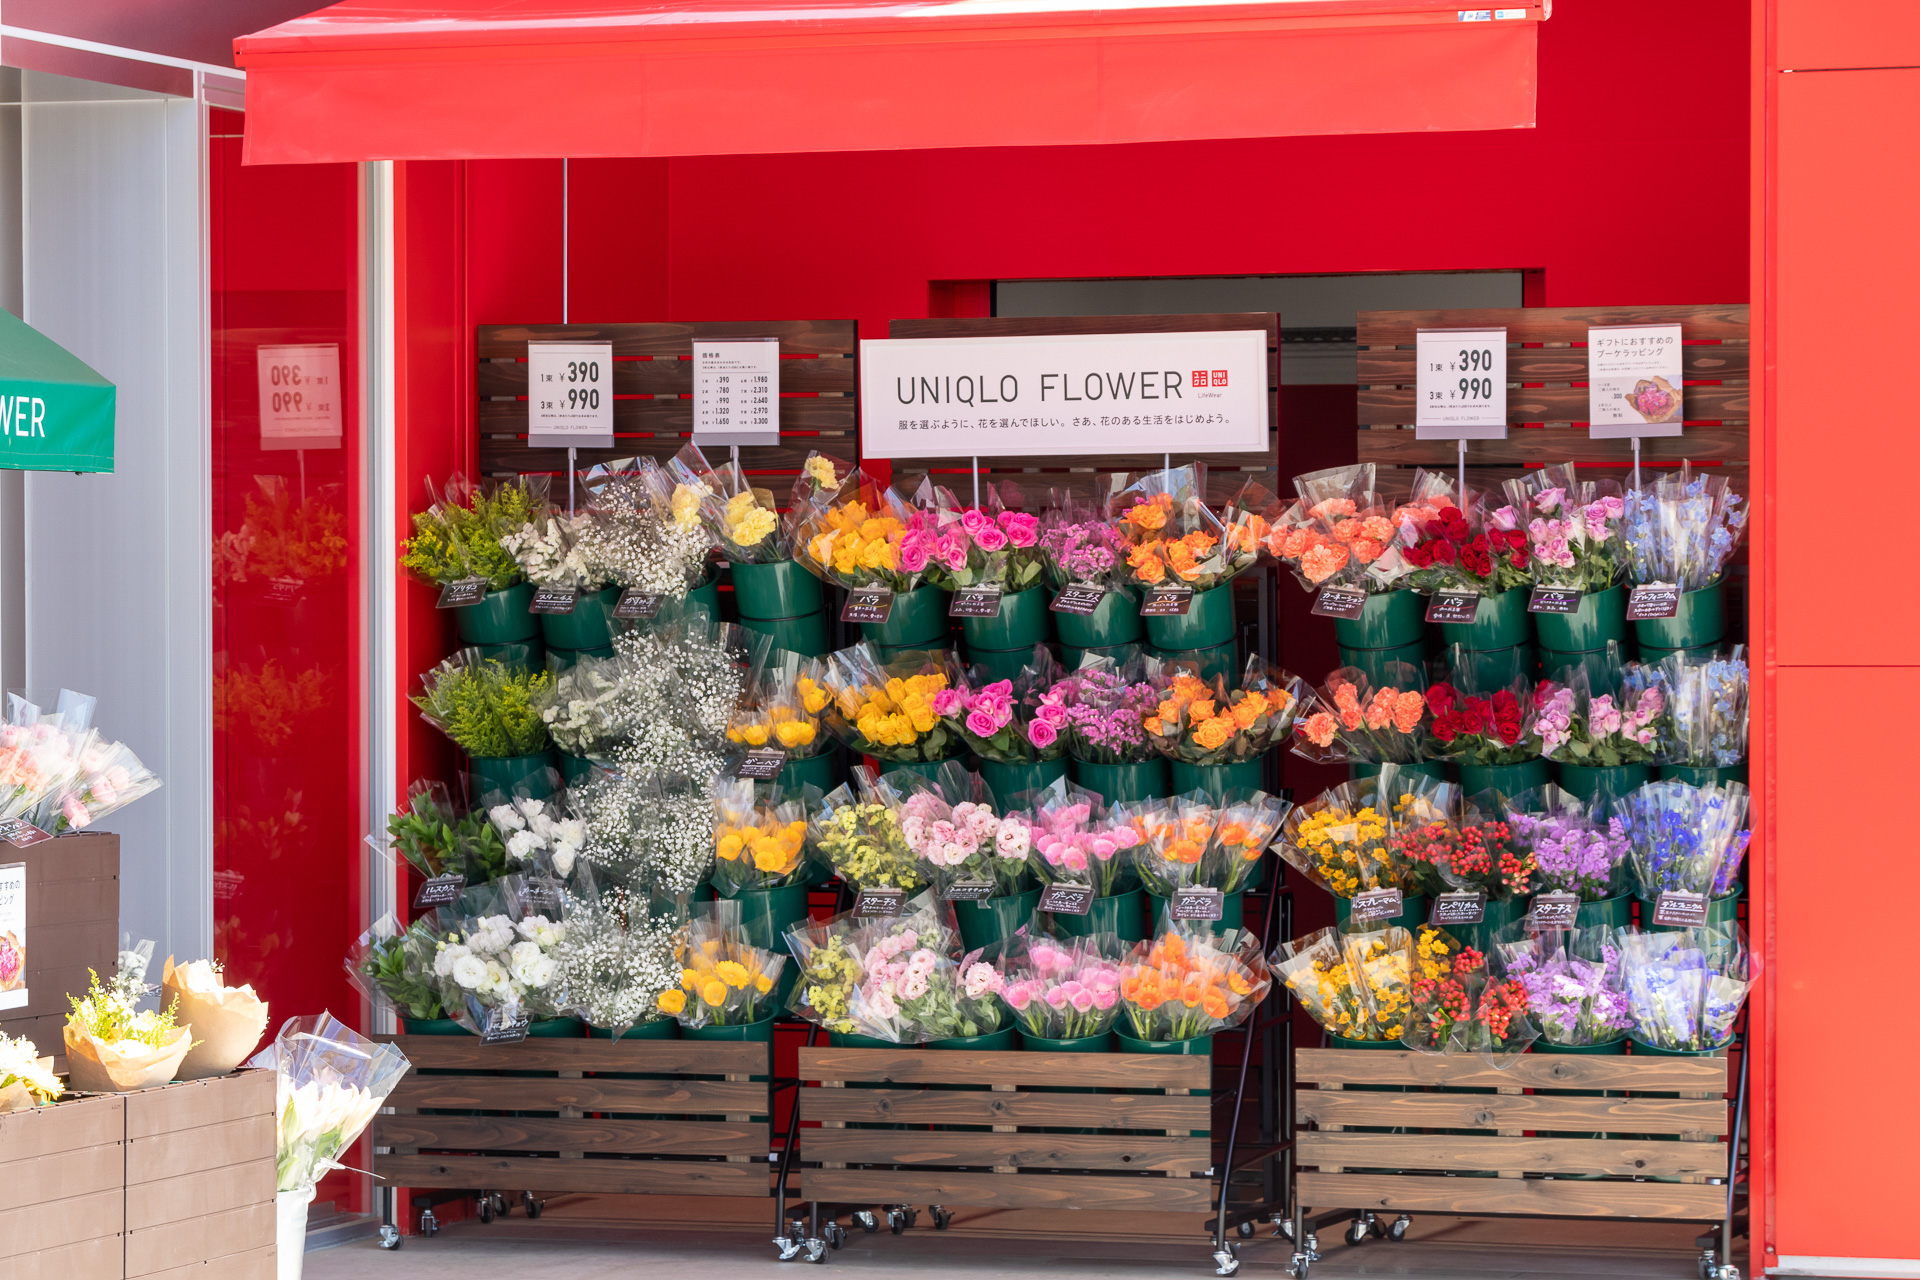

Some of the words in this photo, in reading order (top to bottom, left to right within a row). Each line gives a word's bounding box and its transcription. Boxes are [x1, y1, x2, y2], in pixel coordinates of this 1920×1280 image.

[1597, 336, 1673, 346] ギフトにおすすめの
[1597, 348, 1663, 358] ブーケラッピング
[1430, 363, 1443, 371] 1束
[541, 374, 553, 382] 1束
[897, 374, 1019, 407] UNIQLO
[1040, 371, 1183, 402] FLOWER
[1430, 391, 1443, 400] 3束
[541, 401, 553, 409] 3束
[860, 595, 879, 605] バラ
[966, 593, 984, 601] バラ
[1065, 590, 1100, 602] スターチス
[1156, 594, 1177, 602] バラ
[1323, 592, 1364, 603] カーネーション
[1543, 592, 1565, 600] バラ
[1635, 592, 1677, 602] デルフィニウム
[1443, 597, 1464, 607] バラ
[426, 885, 455, 894] ルスカス
[1052, 891, 1085, 902] ガーベラ
[862, 897, 897, 906] スターチス
[1181, 896, 1212, 907] ガーベラ
[1440, 902, 1479, 910] ヒペリカム
[1661, 901, 1703, 910] デルフィニウム
[1535, 904, 1573, 914] スターチス
